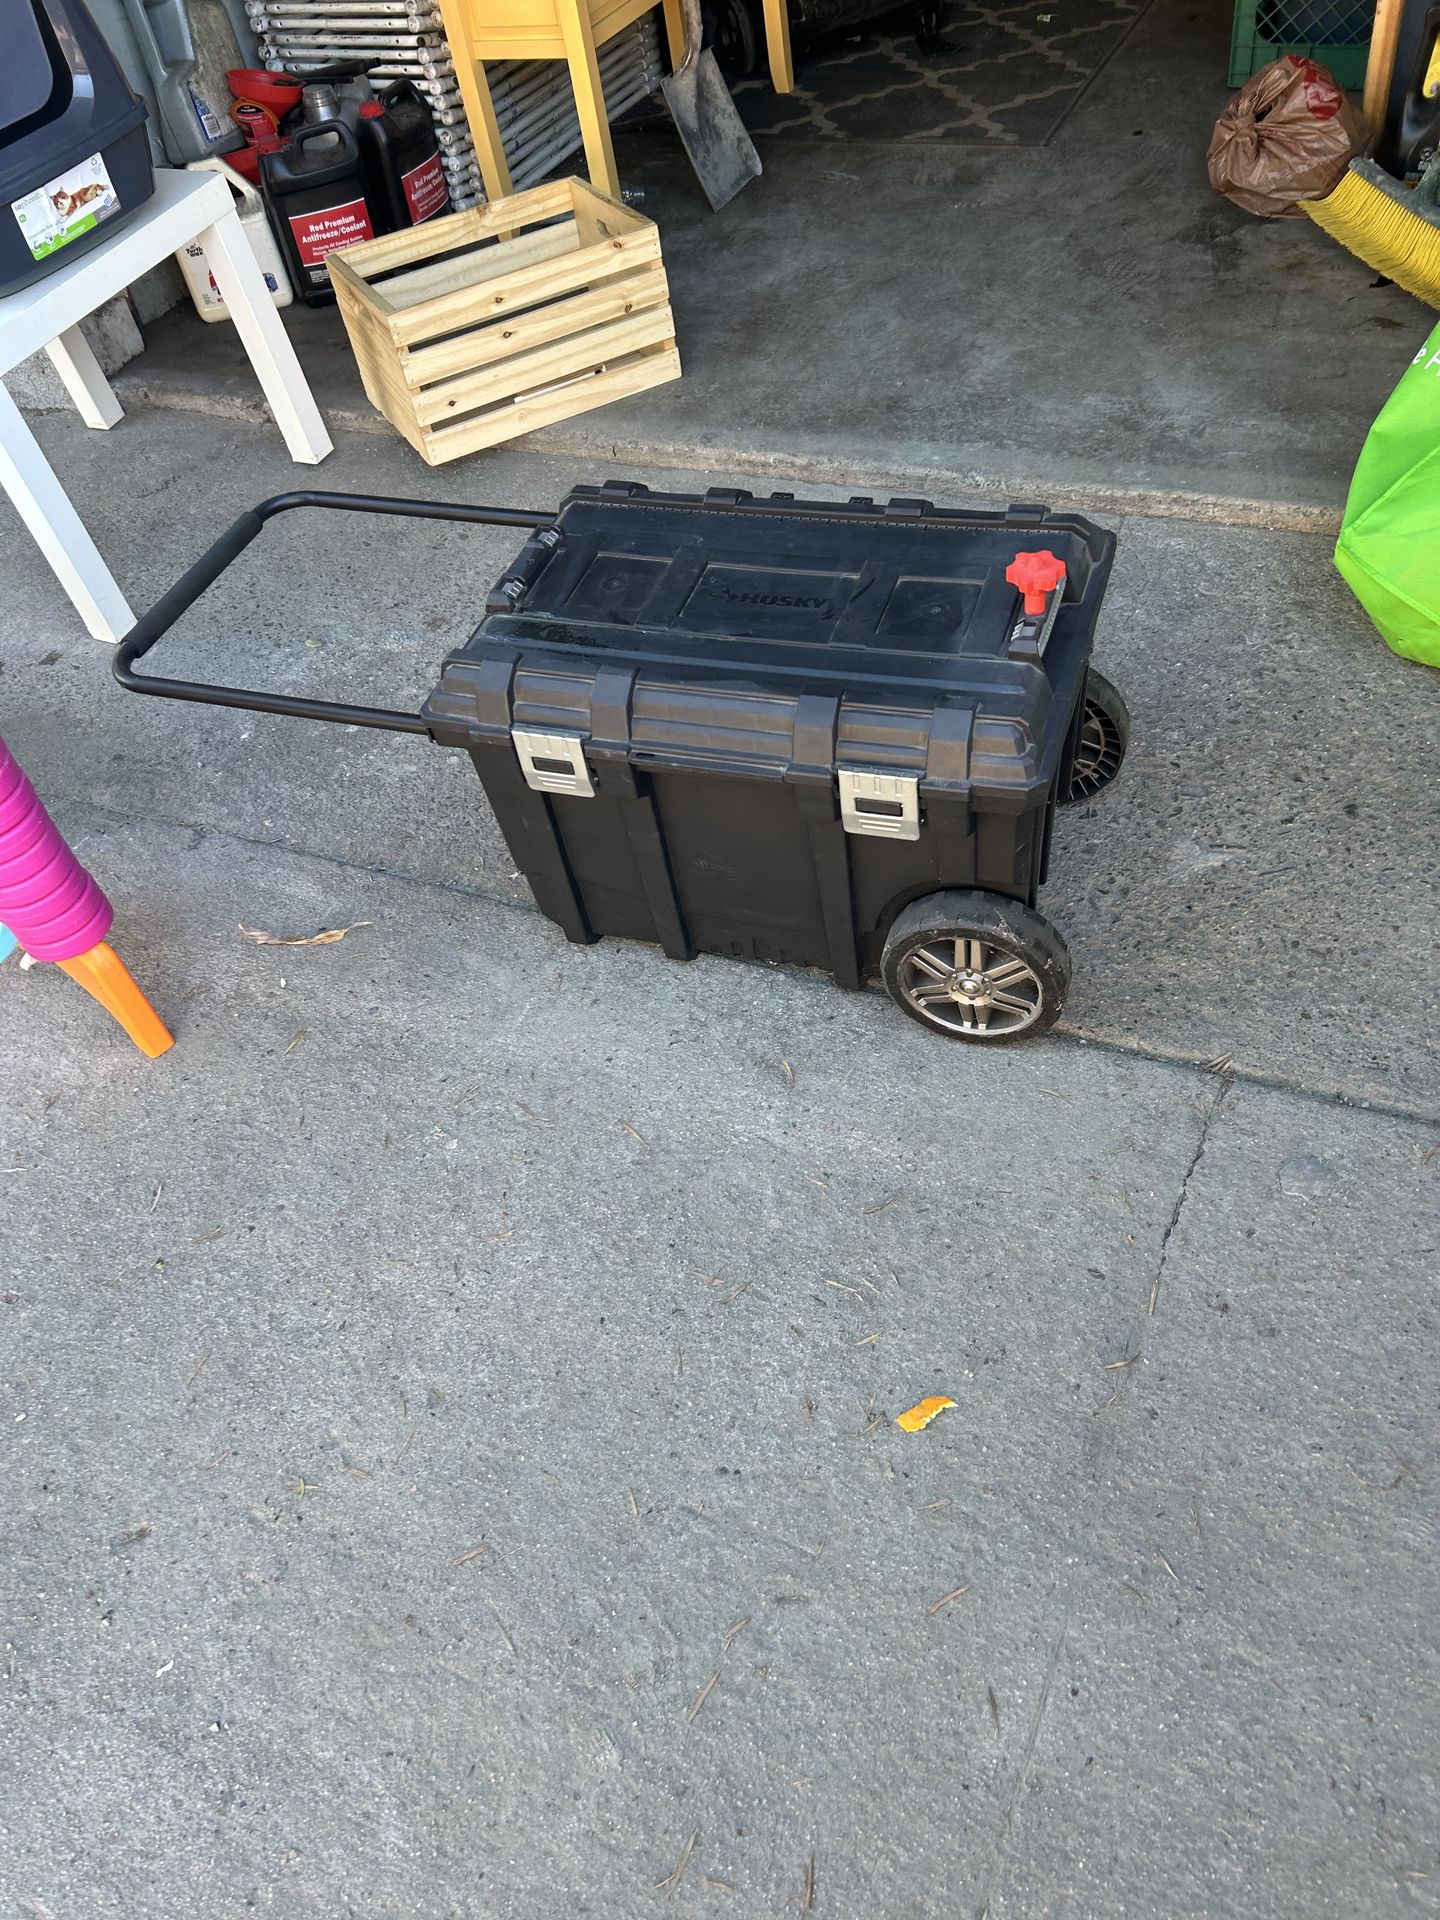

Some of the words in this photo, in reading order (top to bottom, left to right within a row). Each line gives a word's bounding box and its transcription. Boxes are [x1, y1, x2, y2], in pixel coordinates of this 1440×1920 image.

[302, 220, 367, 244] Antifreeze/Coolant
[309, 222, 324, 233] Red
[324, 215, 356, 230] Premium
[739, 592, 831, 609] HUSKY
